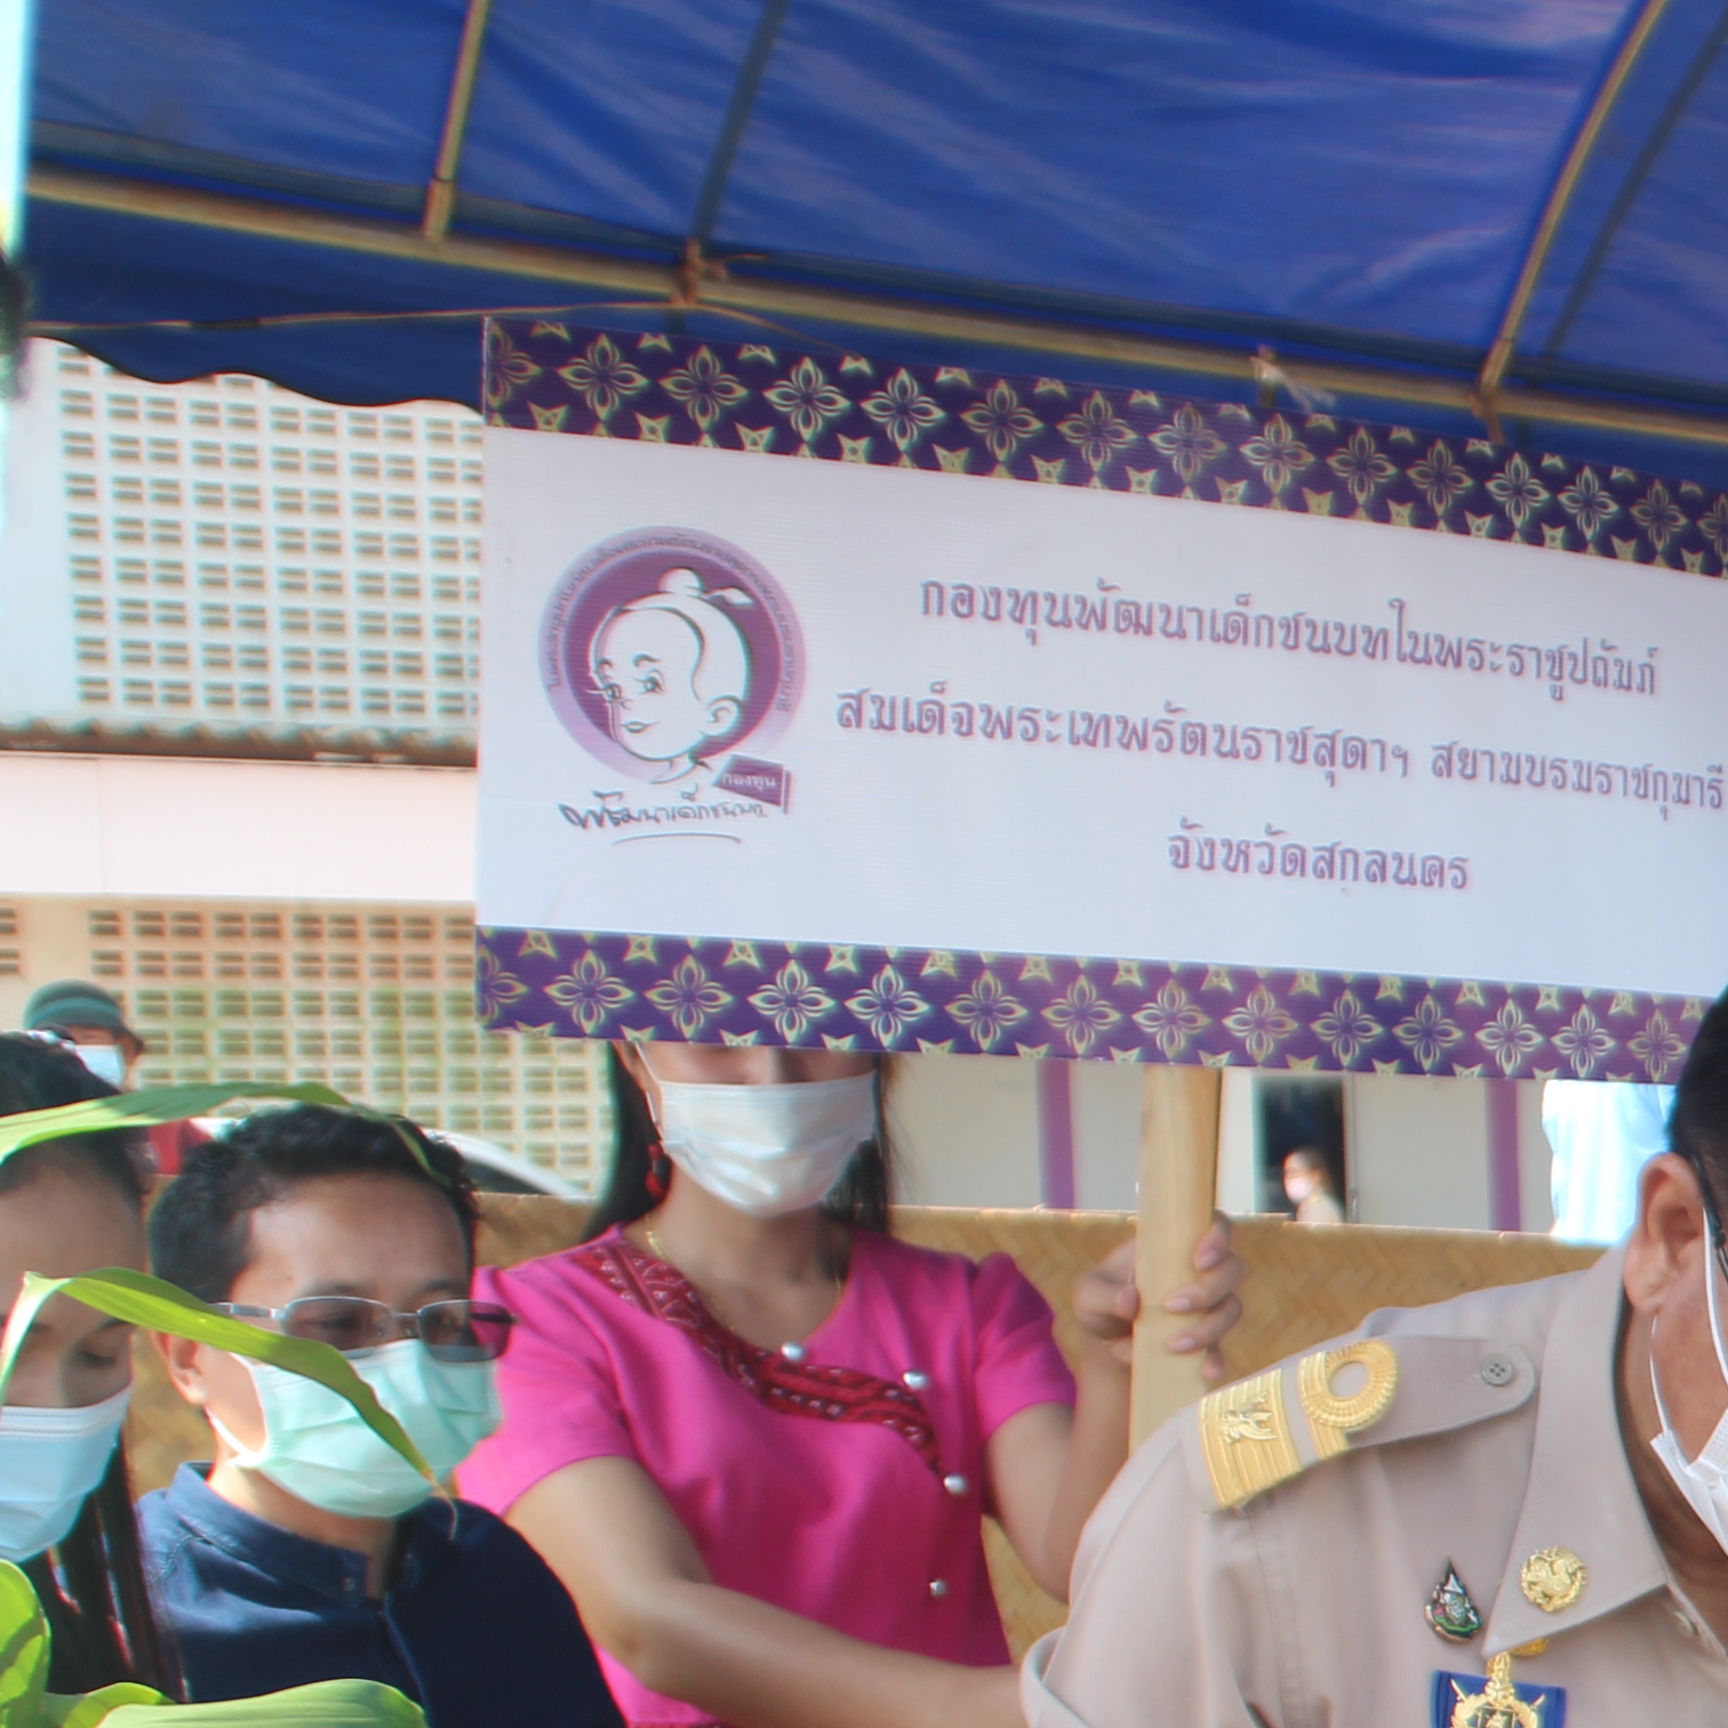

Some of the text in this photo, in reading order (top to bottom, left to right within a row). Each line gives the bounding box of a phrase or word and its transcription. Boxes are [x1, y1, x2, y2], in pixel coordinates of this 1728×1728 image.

[919, 576, 1659, 701] กองทุนพัฒนาเด็กชนบทในพระราชูปถัมภ์
[835, 680, 1725, 821] สมเด็จพระเทพรัตนราชสุดาฯ สยามบรมราชกุมารี
[1166, 815, 1469, 891] จังหวัดสกลนคร
